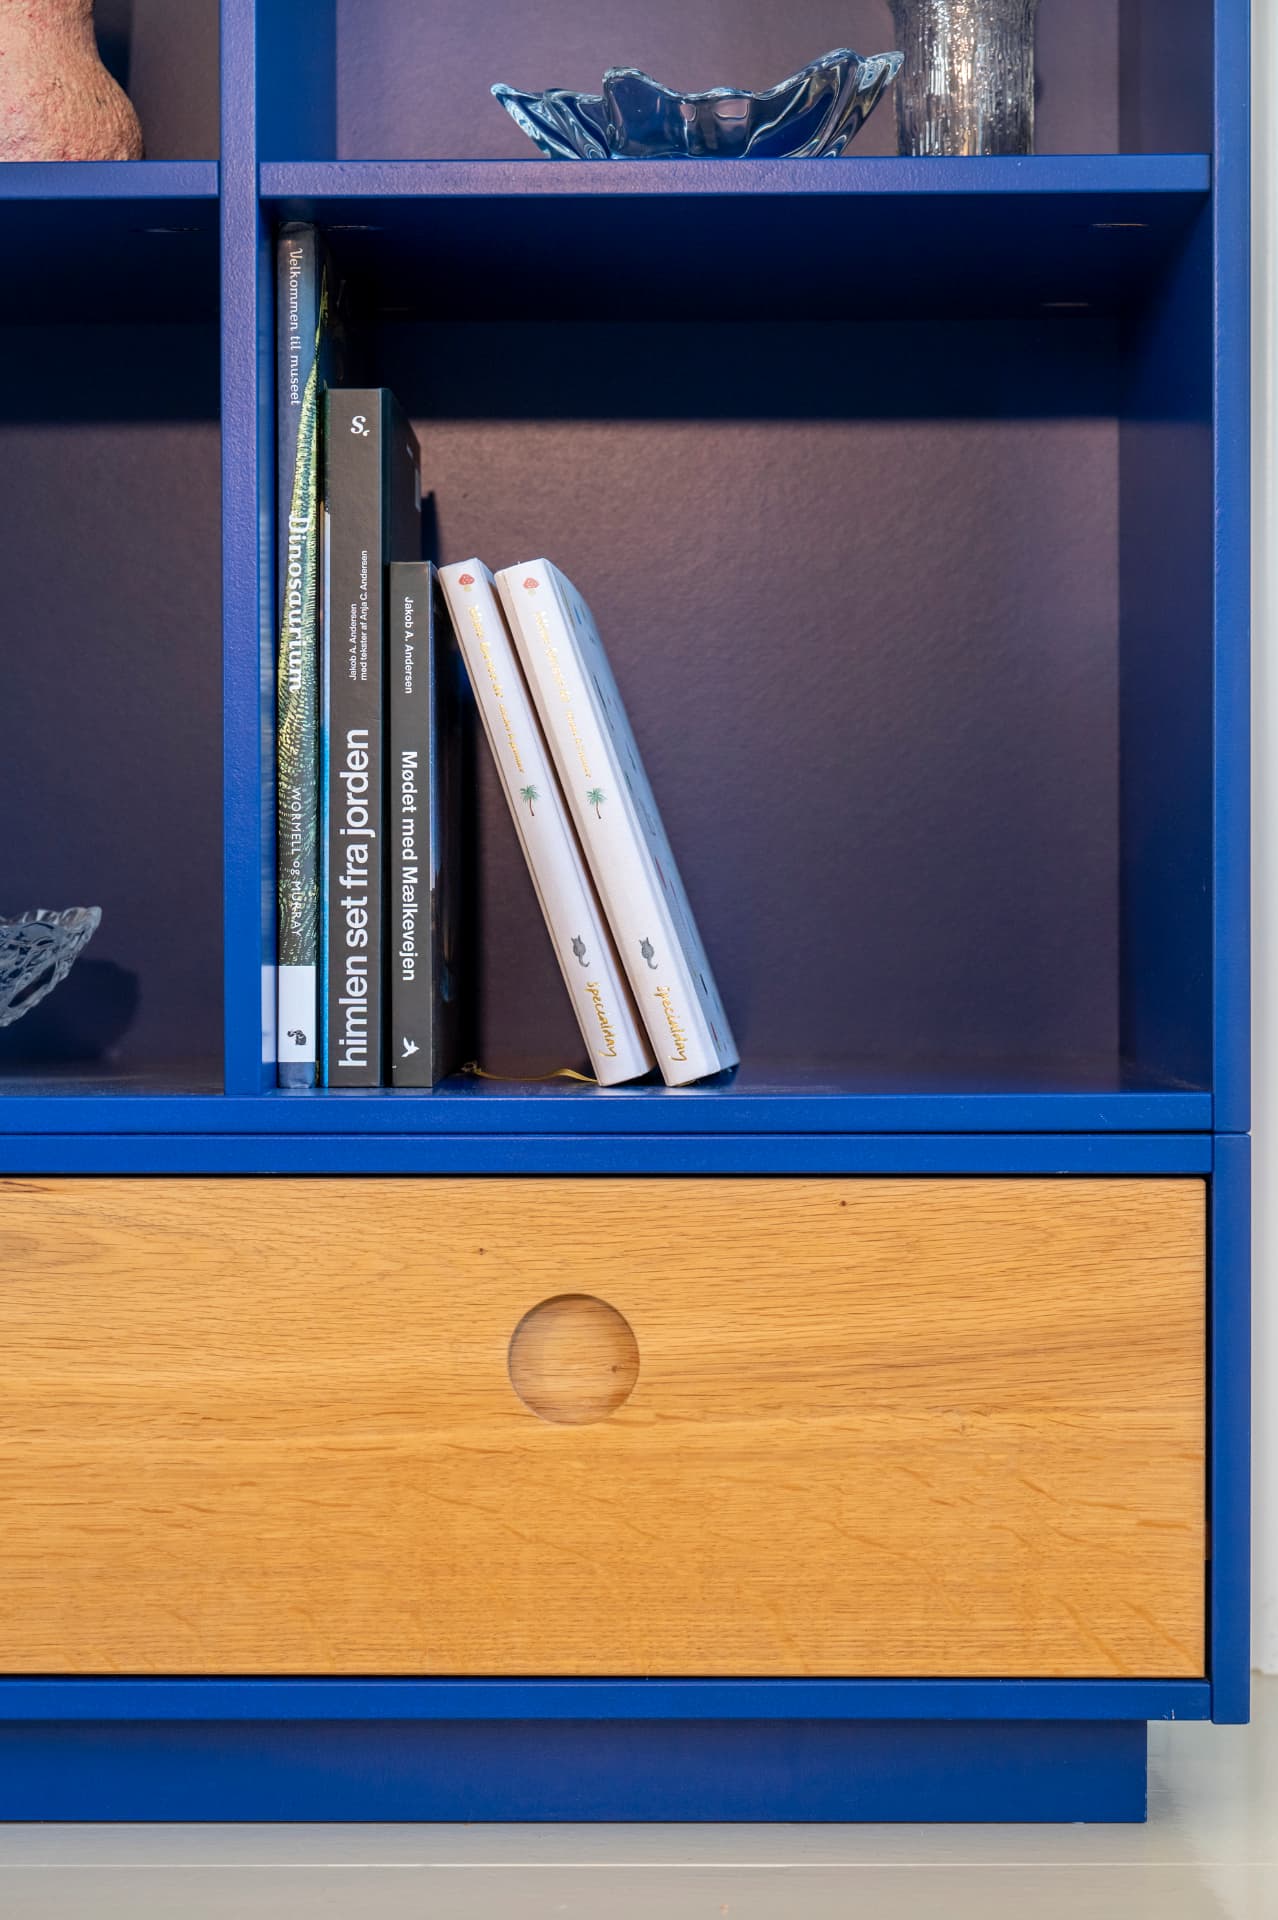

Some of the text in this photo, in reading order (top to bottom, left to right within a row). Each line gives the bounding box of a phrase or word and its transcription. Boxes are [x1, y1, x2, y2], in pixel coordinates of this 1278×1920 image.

[289, 247, 304, 406] Velkommen til museet
[288, 514, 311, 694] Dinosaurium
[360, 550, 368, 590] Andersen
[360, 602, 369, 620] Anja
[360, 620, 368, 630] af
[349, 603, 357, 680] Jakob A. Andersen
[404, 596, 414, 694] Jakob A. Andersen
[290, 787, 302, 938] WORMELL og MURRAY
[338, 729, 376, 1067] himlen set fra jorden
[399, 751, 419, 981] Mødet med Mælkevejen
